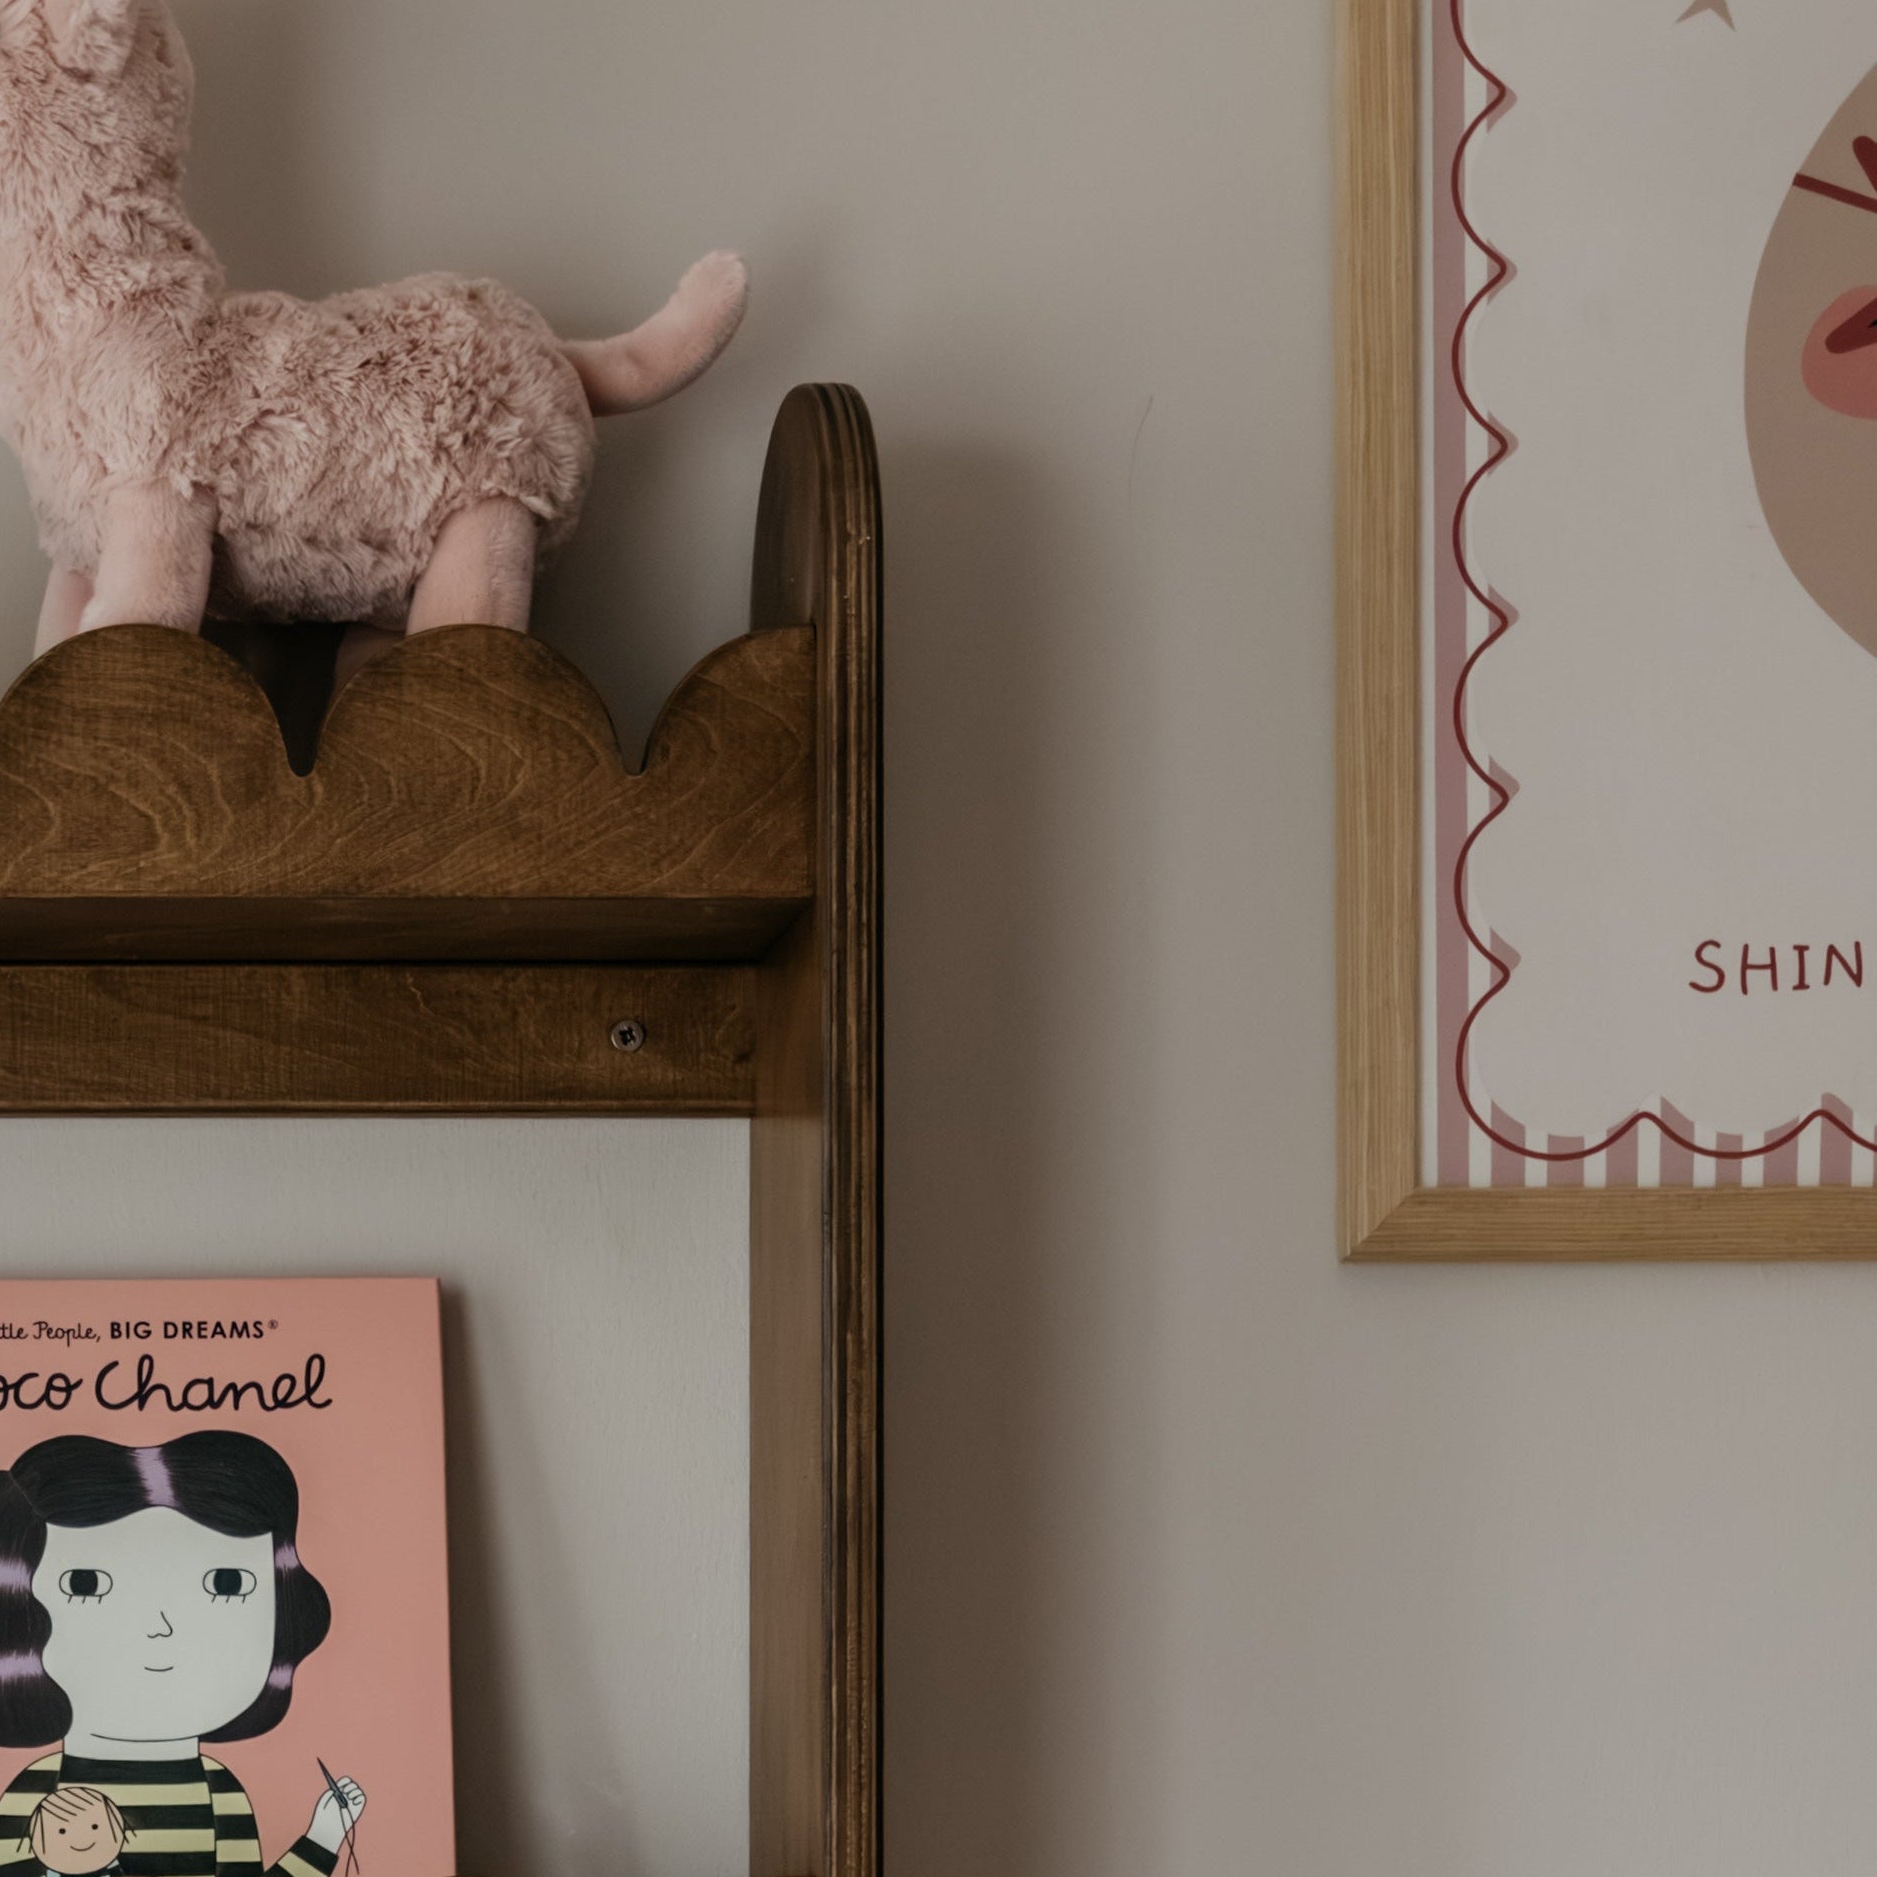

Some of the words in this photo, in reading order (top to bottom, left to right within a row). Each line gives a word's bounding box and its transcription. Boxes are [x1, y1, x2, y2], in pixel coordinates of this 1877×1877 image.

[33, 1320, 102, 1347] People,
[110, 1320, 152, 1340] BIG
[94, 1353, 333, 1412] Chanel
